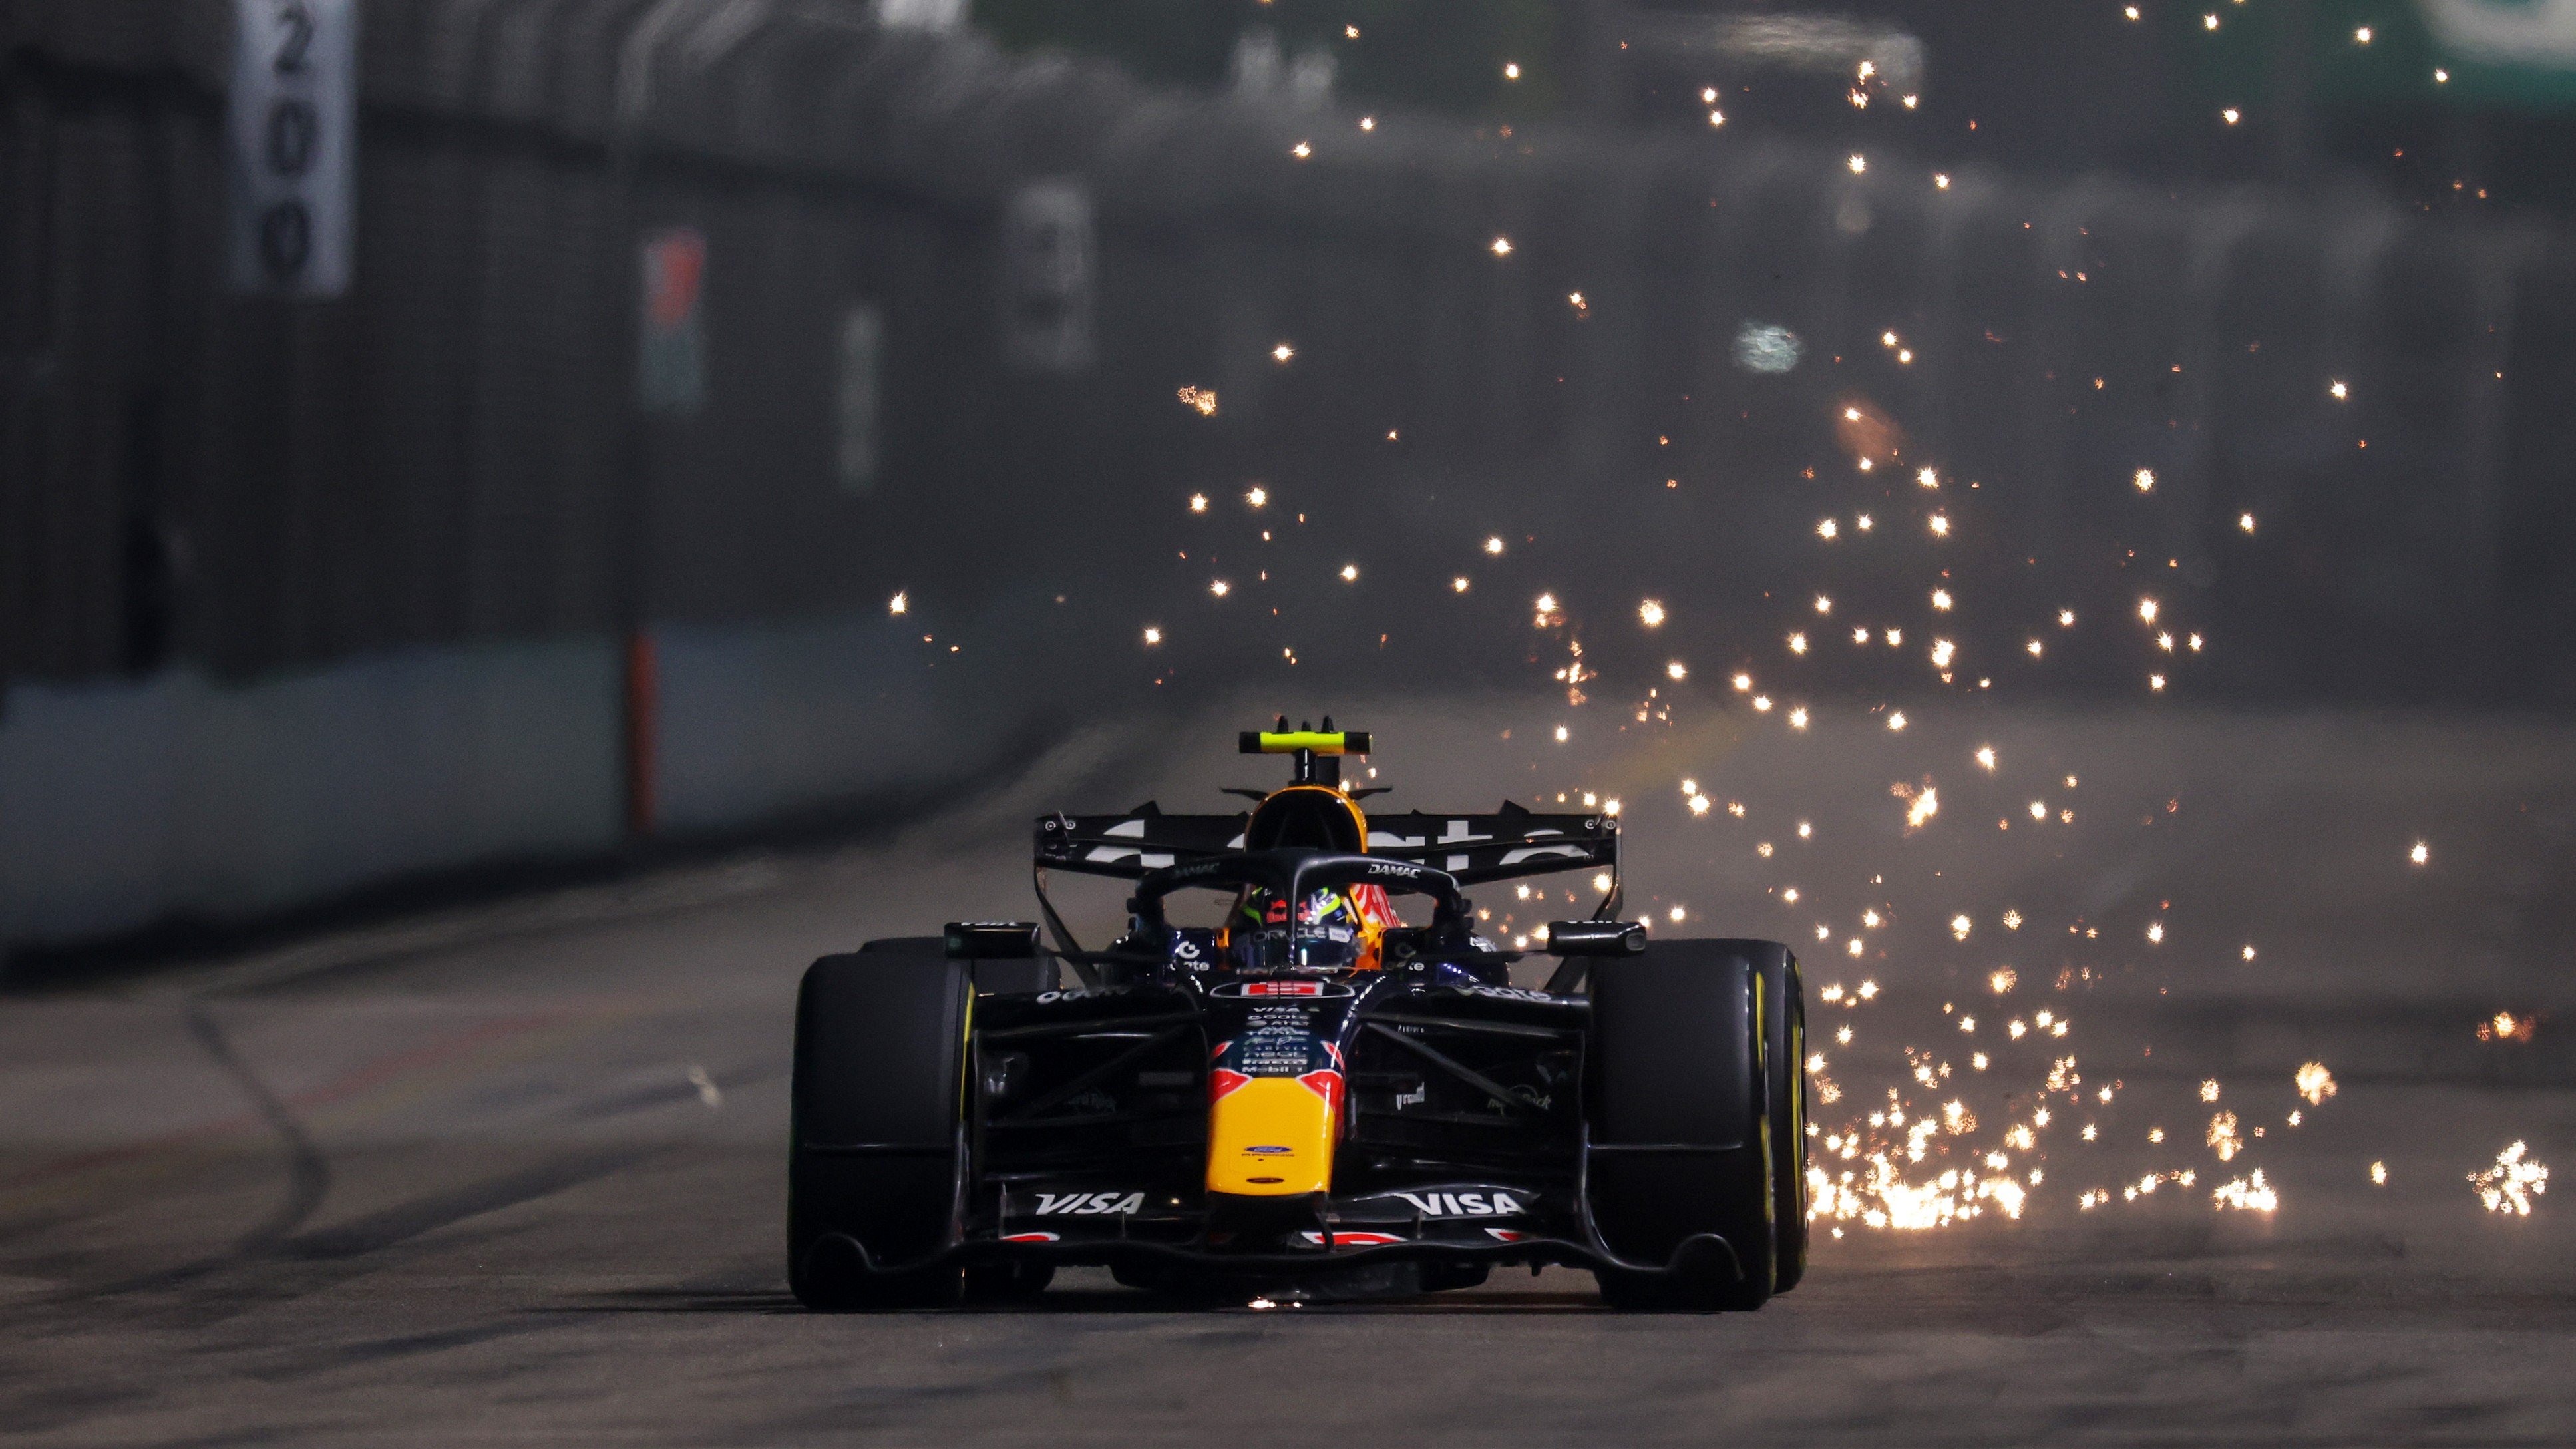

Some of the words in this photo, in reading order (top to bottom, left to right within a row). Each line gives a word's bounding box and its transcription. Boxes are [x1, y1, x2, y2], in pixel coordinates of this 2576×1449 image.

[1368, 864, 1422, 879] DAMAC
[1035, 1192, 1146, 1215] VISA
[1396, 1193, 1527, 1215] VISA
